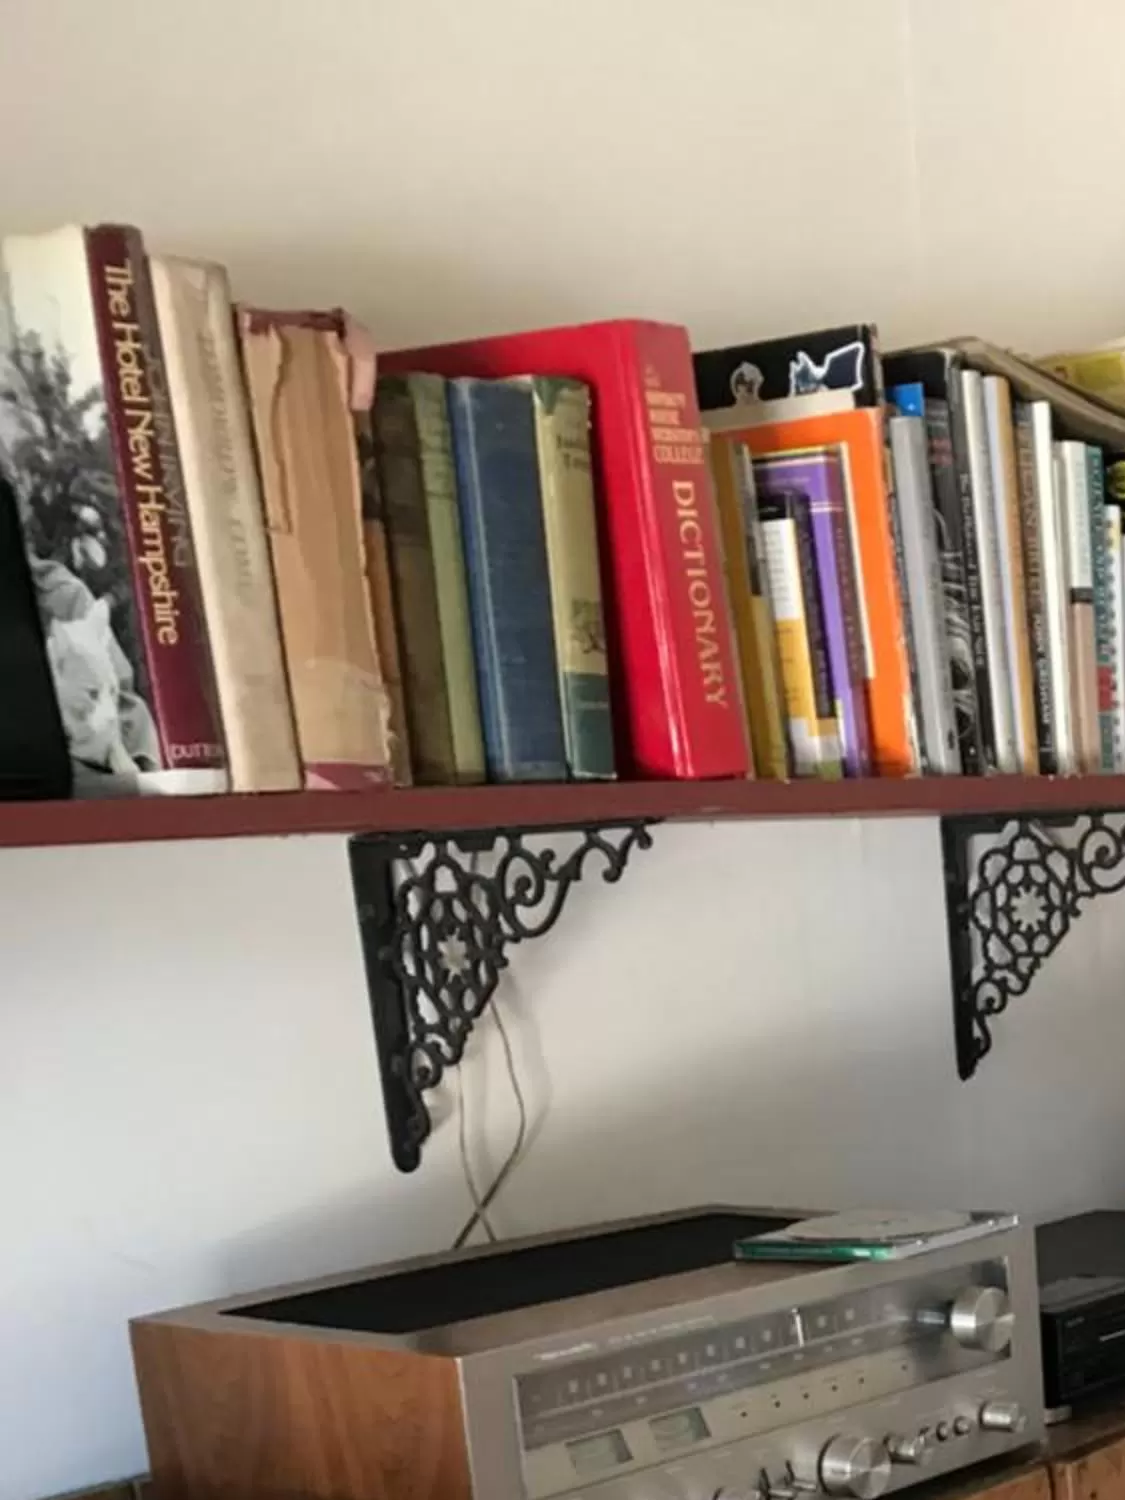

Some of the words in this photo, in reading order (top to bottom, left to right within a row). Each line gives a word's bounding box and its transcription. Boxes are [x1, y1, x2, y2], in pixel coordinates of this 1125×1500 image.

[104, 258, 134, 318] The
[112, 322, 151, 403] Hotel
[125, 408, 155, 480] New
[135, 484, 180, 646] Hampshire
[672, 479, 728, 709] DICTIONARY
